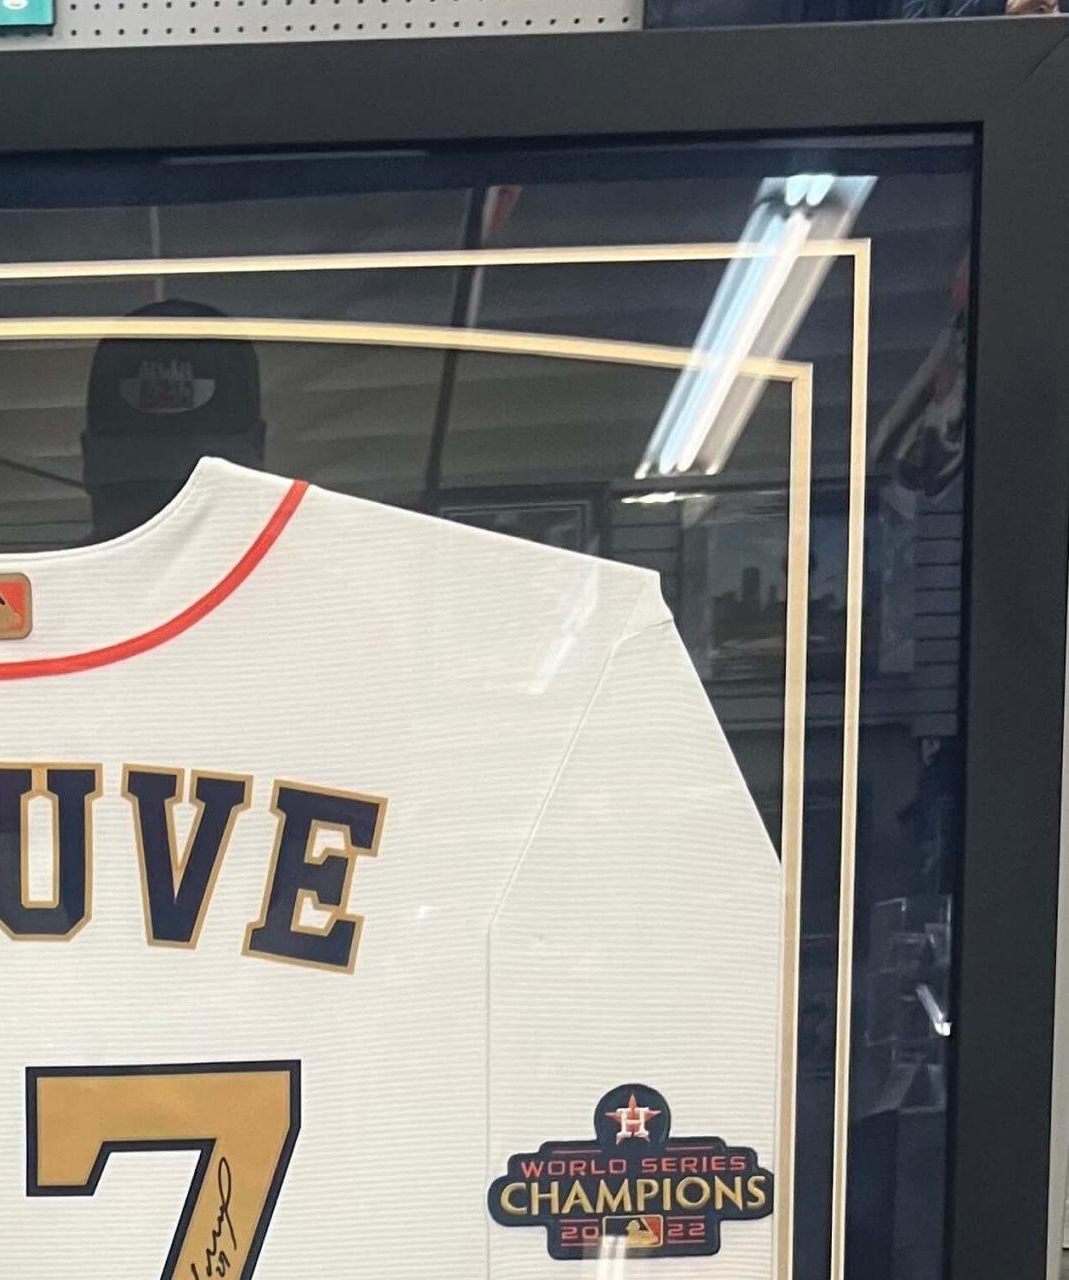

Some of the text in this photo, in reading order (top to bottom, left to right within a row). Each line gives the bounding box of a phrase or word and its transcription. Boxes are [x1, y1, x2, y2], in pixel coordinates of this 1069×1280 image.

[521, 1155, 747, 1178] WORLD SERIES
[500, 1175, 766, 1216] CHAMPIONS
[561, 1222, 706, 1240] 20 22
